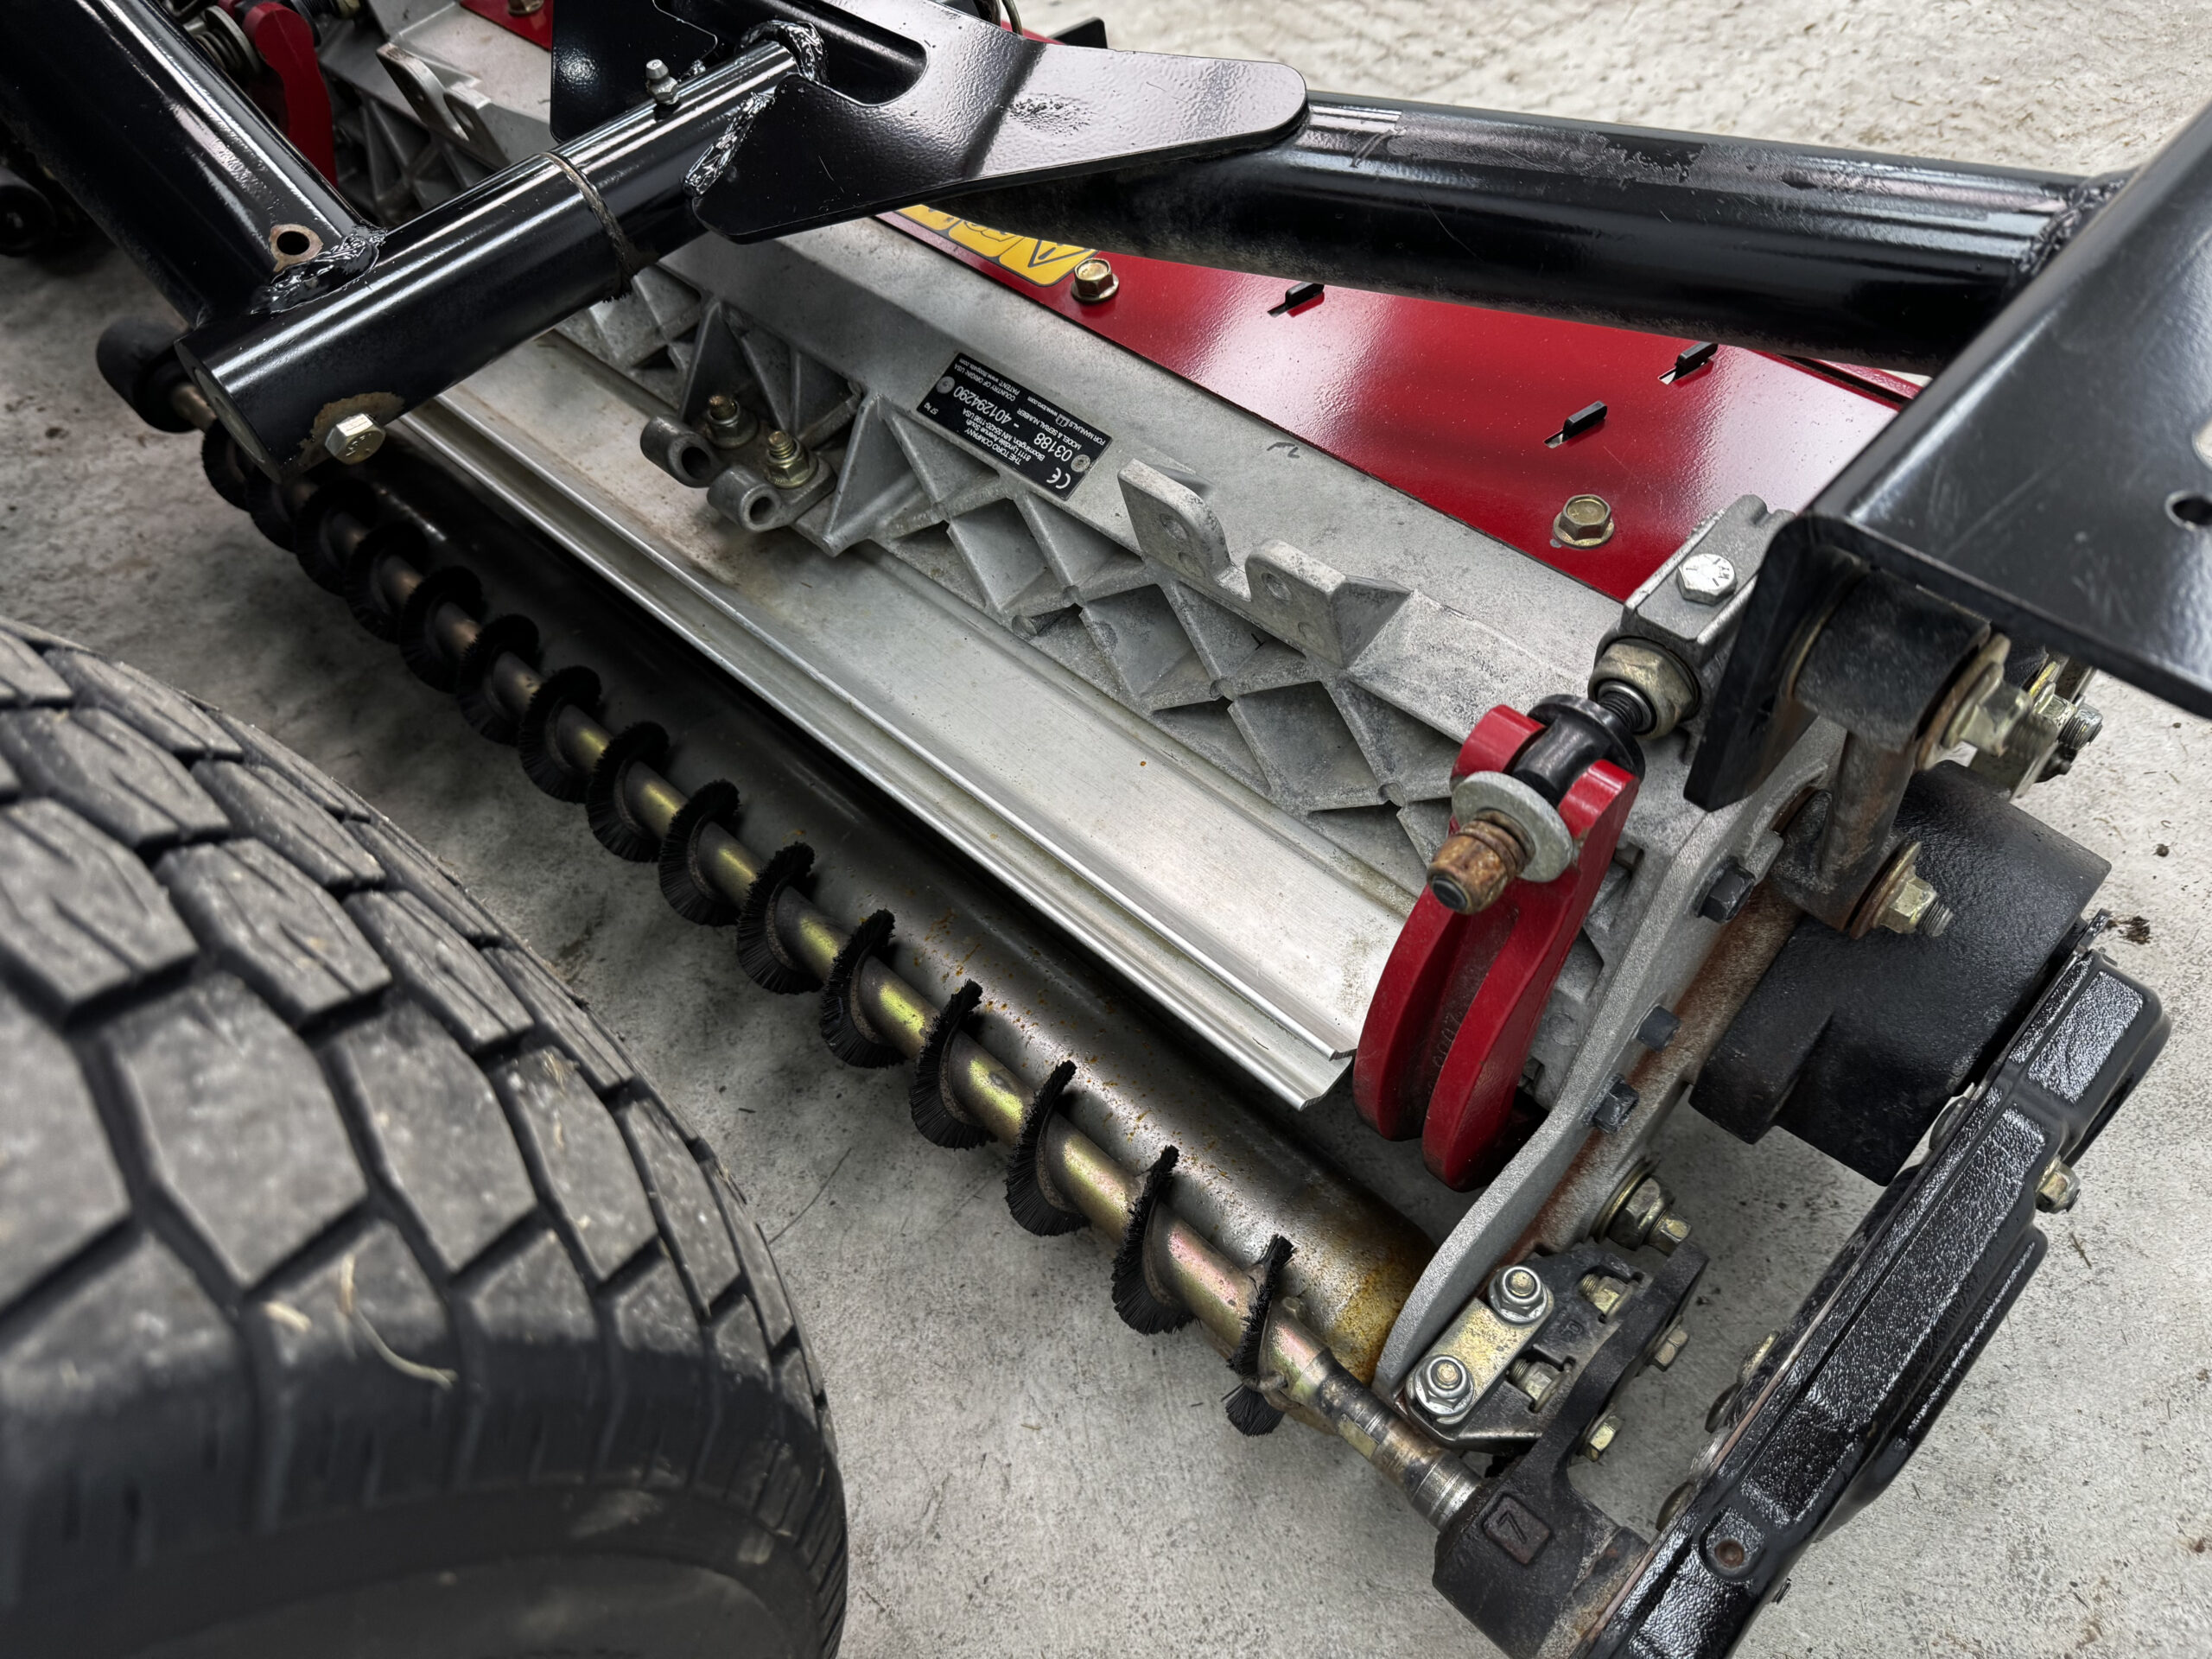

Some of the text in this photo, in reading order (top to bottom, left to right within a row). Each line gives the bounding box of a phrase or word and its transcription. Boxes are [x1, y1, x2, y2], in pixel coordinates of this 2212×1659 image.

[954, 363, 966, 373] USA
[989, 385, 1016, 402] COUNTRY
[924, 402, 939, 416] 57 kg
[953, 385, 1013, 424] 401294290
[963, 408, 976, 420] USA
[1016, 408, 1041, 426] NUMBER
[1001, 431, 1014, 442] MN
[1039, 421, 1058, 436] SERIAL
[1068, 421, 1095, 440] MANUALS
[963, 427, 1022, 466] THE TORO COMPANY
[965, 418, 1032, 461] 8111 Lyndale Avenue South
[1033, 432, 1073, 462] 03188
[1062, 434, 1082, 451] MODEL
[1092, 435, 1106, 446] FOR
